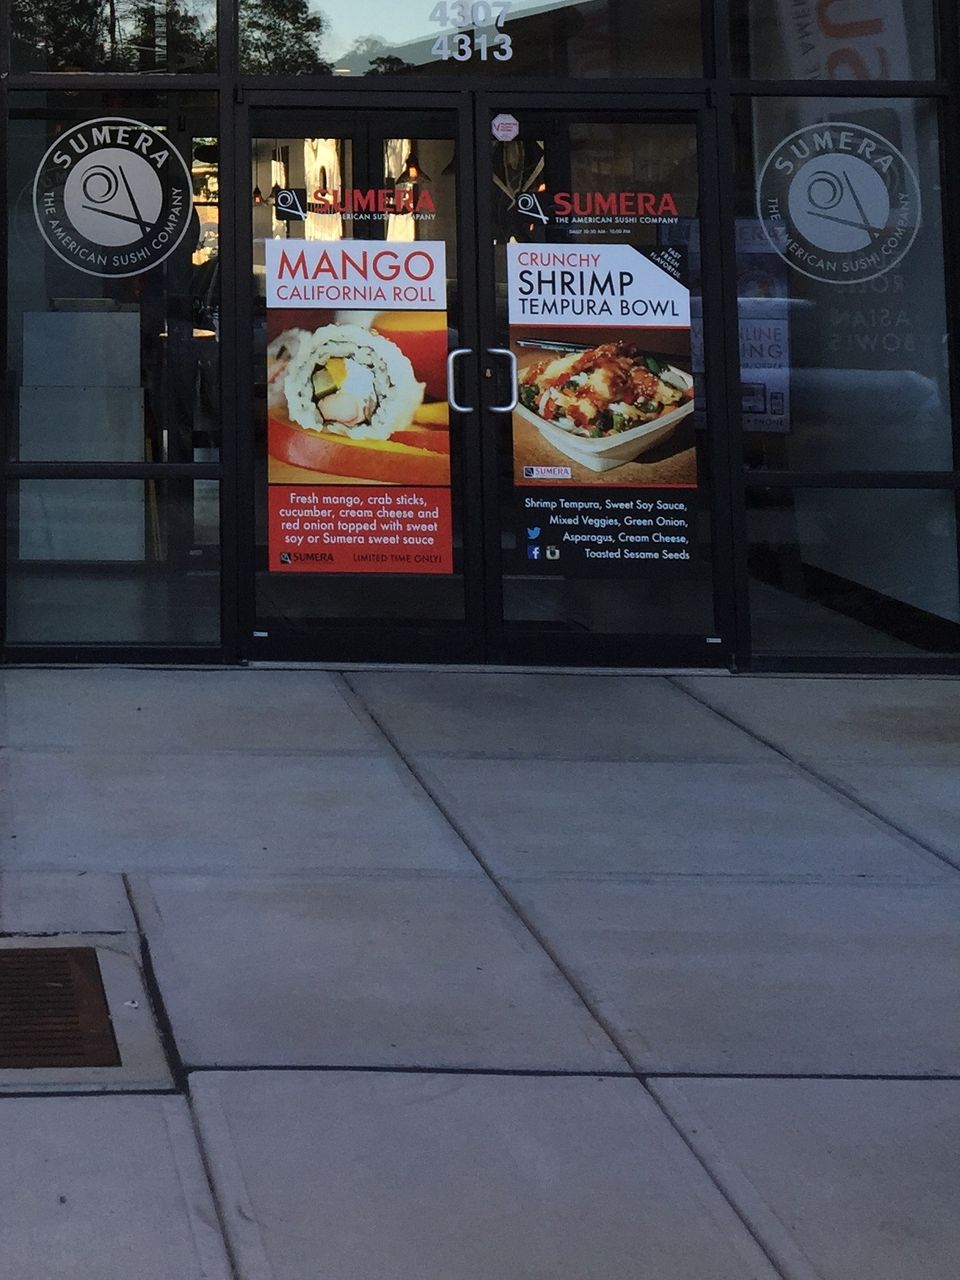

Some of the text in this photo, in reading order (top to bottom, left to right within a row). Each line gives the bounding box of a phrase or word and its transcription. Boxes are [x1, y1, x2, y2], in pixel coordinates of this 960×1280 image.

[429, 0, 512, 27] 4307
[431, 33, 513, 61] 4313
[53, 125, 170, 169] SUMERA
[774, 131, 894, 176] SUMERA
[313, 189, 436, 213] SUMERA
[553, 191, 679, 216] SUMERA
[44, 187, 183, 267] THE AMERICAN SUSHI COMPANY
[614, 217, 638, 225] SUSHI
[640, 217, 679, 225] COMPANY
[768, 198, 781, 221] THE
[842, 253, 880, 273] SUSHI
[881, 192, 909, 256] COMPANY
[518, 252, 600, 267] CRUNCHY
[660, 250, 680, 268] FRESH
[667, 247, 682, 260] FAST
[277, 249, 435, 282] MANGO
[518, 270, 634, 296] SHRIMP
[276, 285, 436, 302] CALIFORNIA ROLL
[518, 298, 680, 317] TEMPURA BOWL
[534, 468, 570, 476] SUMERA
[289, 493, 428, 506] Fresh mango, crab sticks,
[524, 497, 688, 512] Shrimp Tempura, Sweet Soy Sauce,
[279, 506, 439, 519] cucumber, cream cheese and
[281, 519, 438, 533] red onion topped with sweet
[549, 515, 689, 528] Mixed Veggies, Green Onion,
[284, 532, 435, 546] soy or Sumera sweet sauce
[562, 531, 689, 545] Asparagus, Cream Cheese,
[293, 553, 334, 561] SUMERA
[352, 554, 387, 563] LIMITED
[390, 554, 411, 563] TIME
[584, 548, 691, 560] Toasted Sesame Seeds
